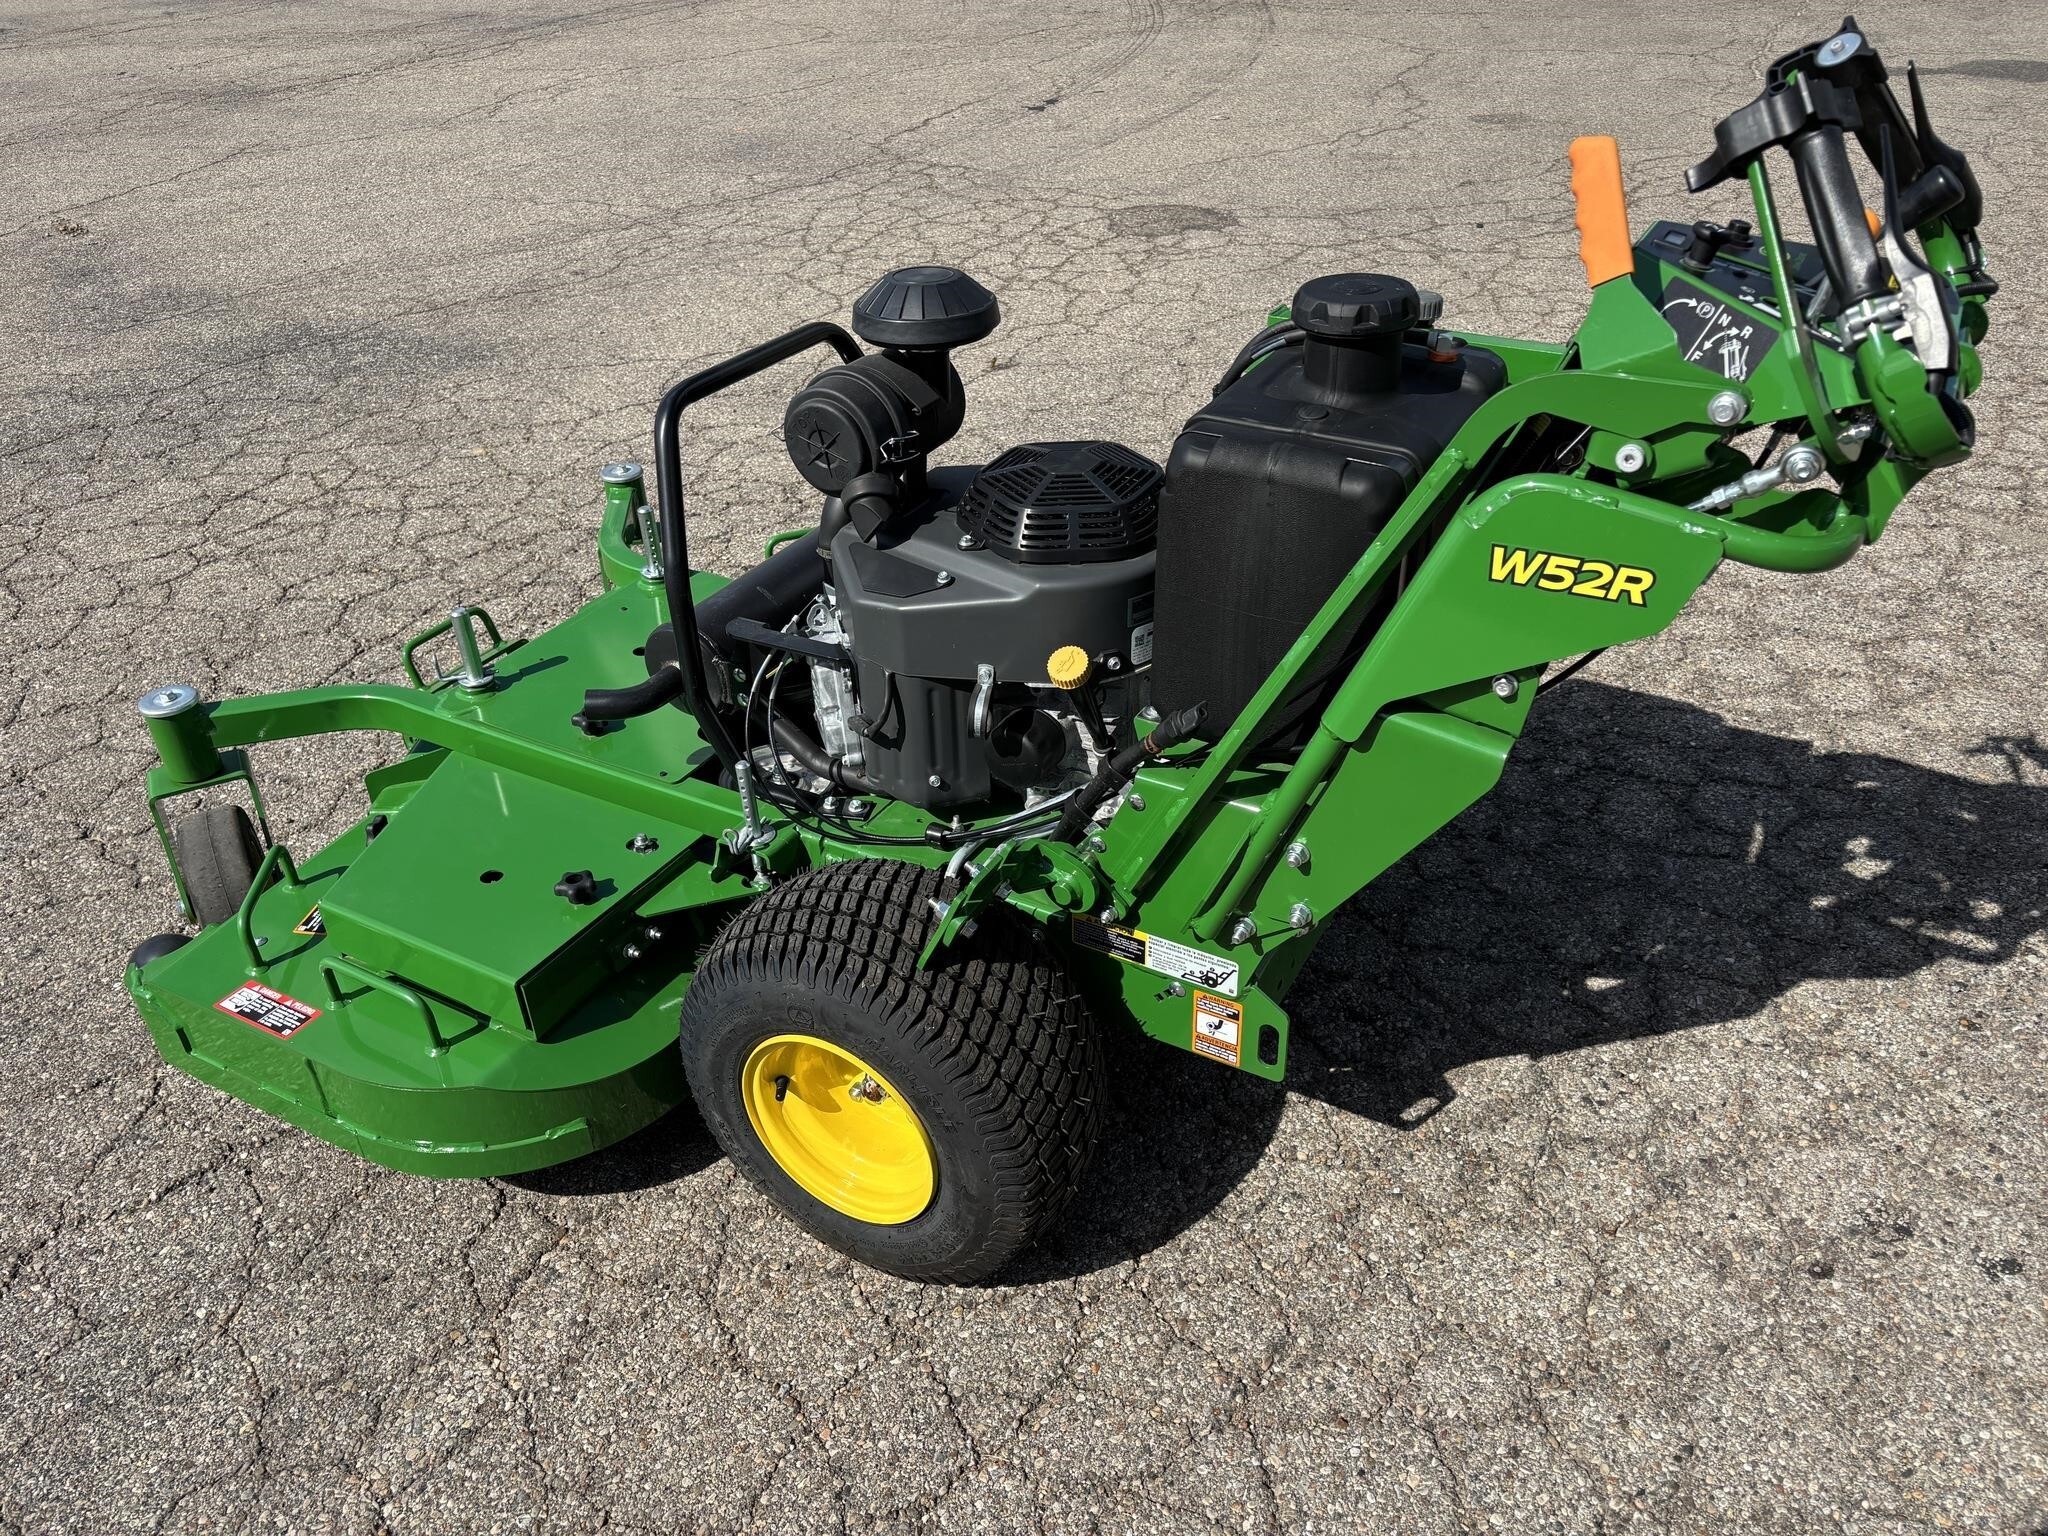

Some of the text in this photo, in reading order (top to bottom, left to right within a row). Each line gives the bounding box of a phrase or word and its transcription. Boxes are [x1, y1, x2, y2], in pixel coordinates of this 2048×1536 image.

[1718, 313, 1732, 327] N
[1740, 325, 1753, 340] R
[1690, 350, 1703, 361] F
[1489, 543, 1656, 608] W52R
[1208, 995, 1234, 1008] WARNING
[1201, 1035, 1238, 1051] ADVERTENCIA
